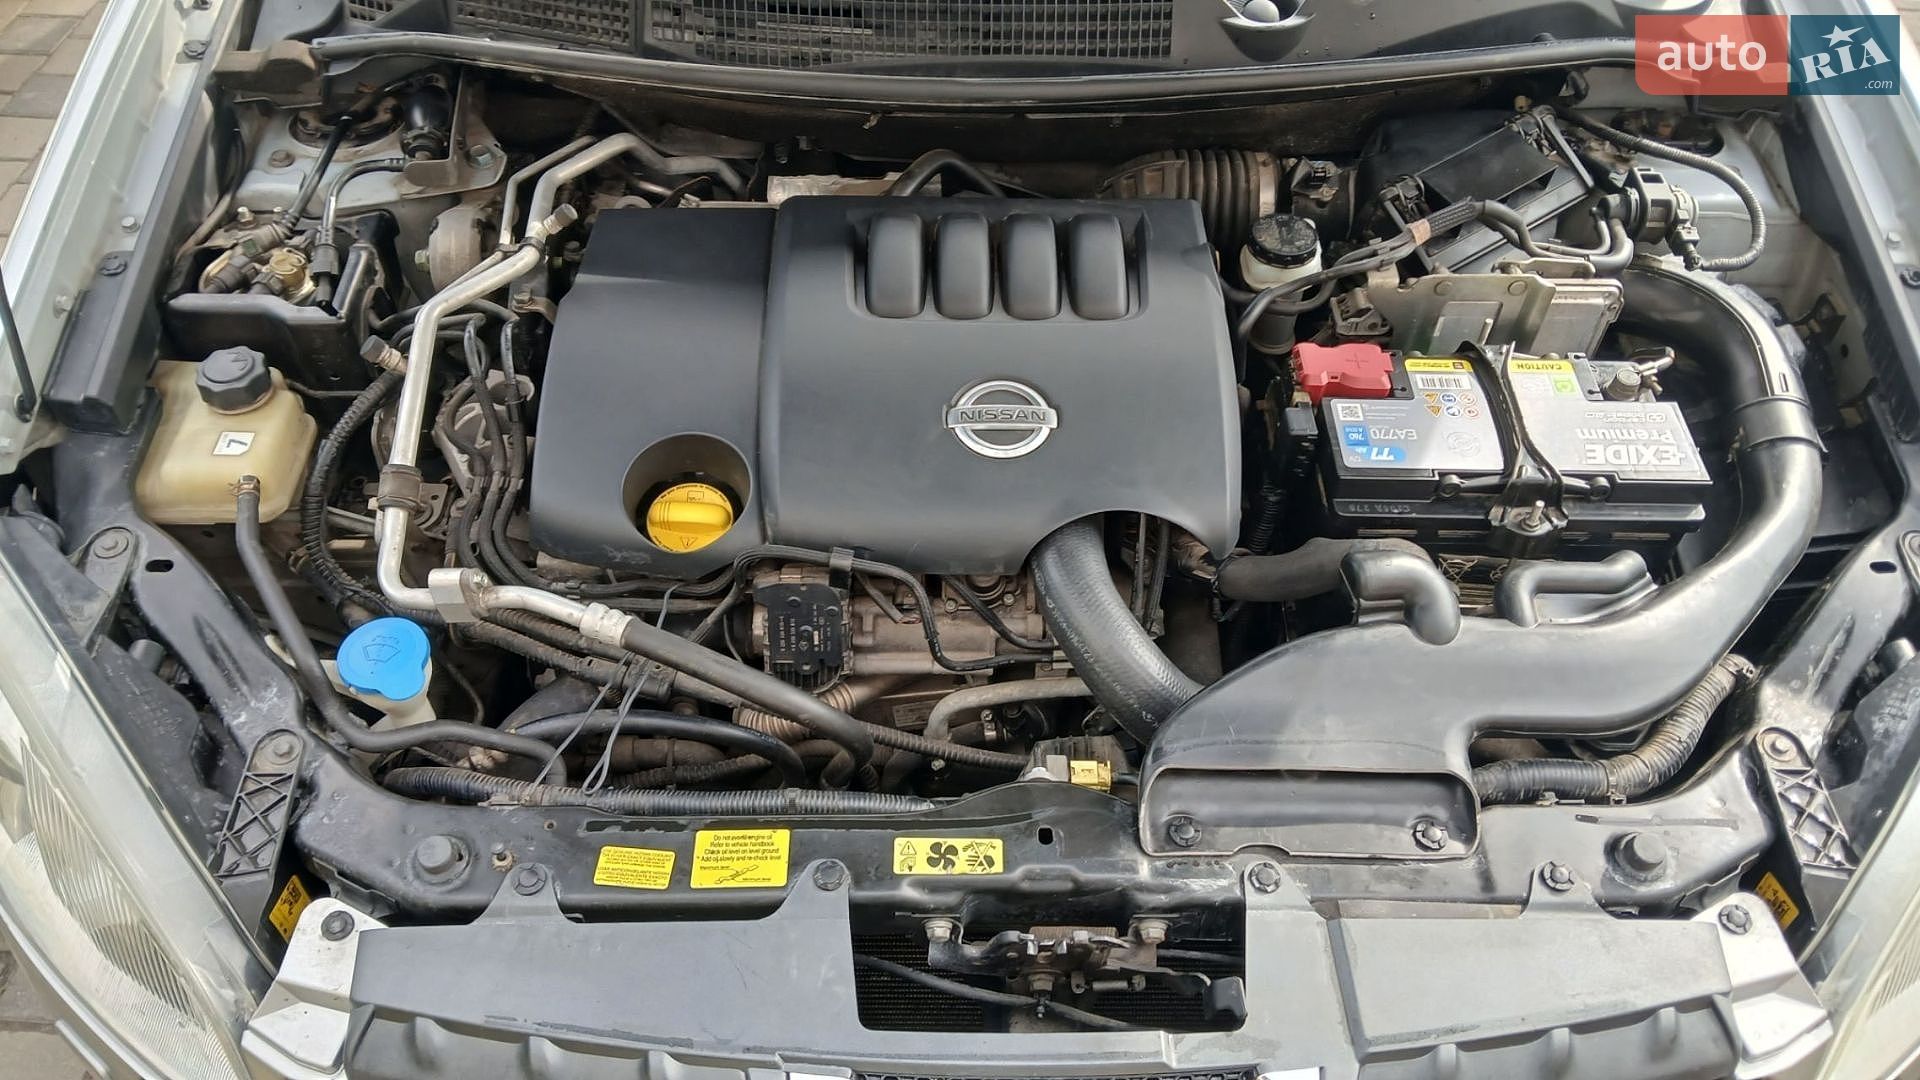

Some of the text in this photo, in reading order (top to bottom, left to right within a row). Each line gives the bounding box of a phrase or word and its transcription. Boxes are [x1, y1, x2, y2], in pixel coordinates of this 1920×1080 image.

[960, 409, 1046, 422] NISSAN
[1369, 428, 1417, 440] EA770
[1576, 428, 1677, 444] Premium
[1370, 447, 1395, 460] 77
[1584, 444, 1686, 465] EXIDE
